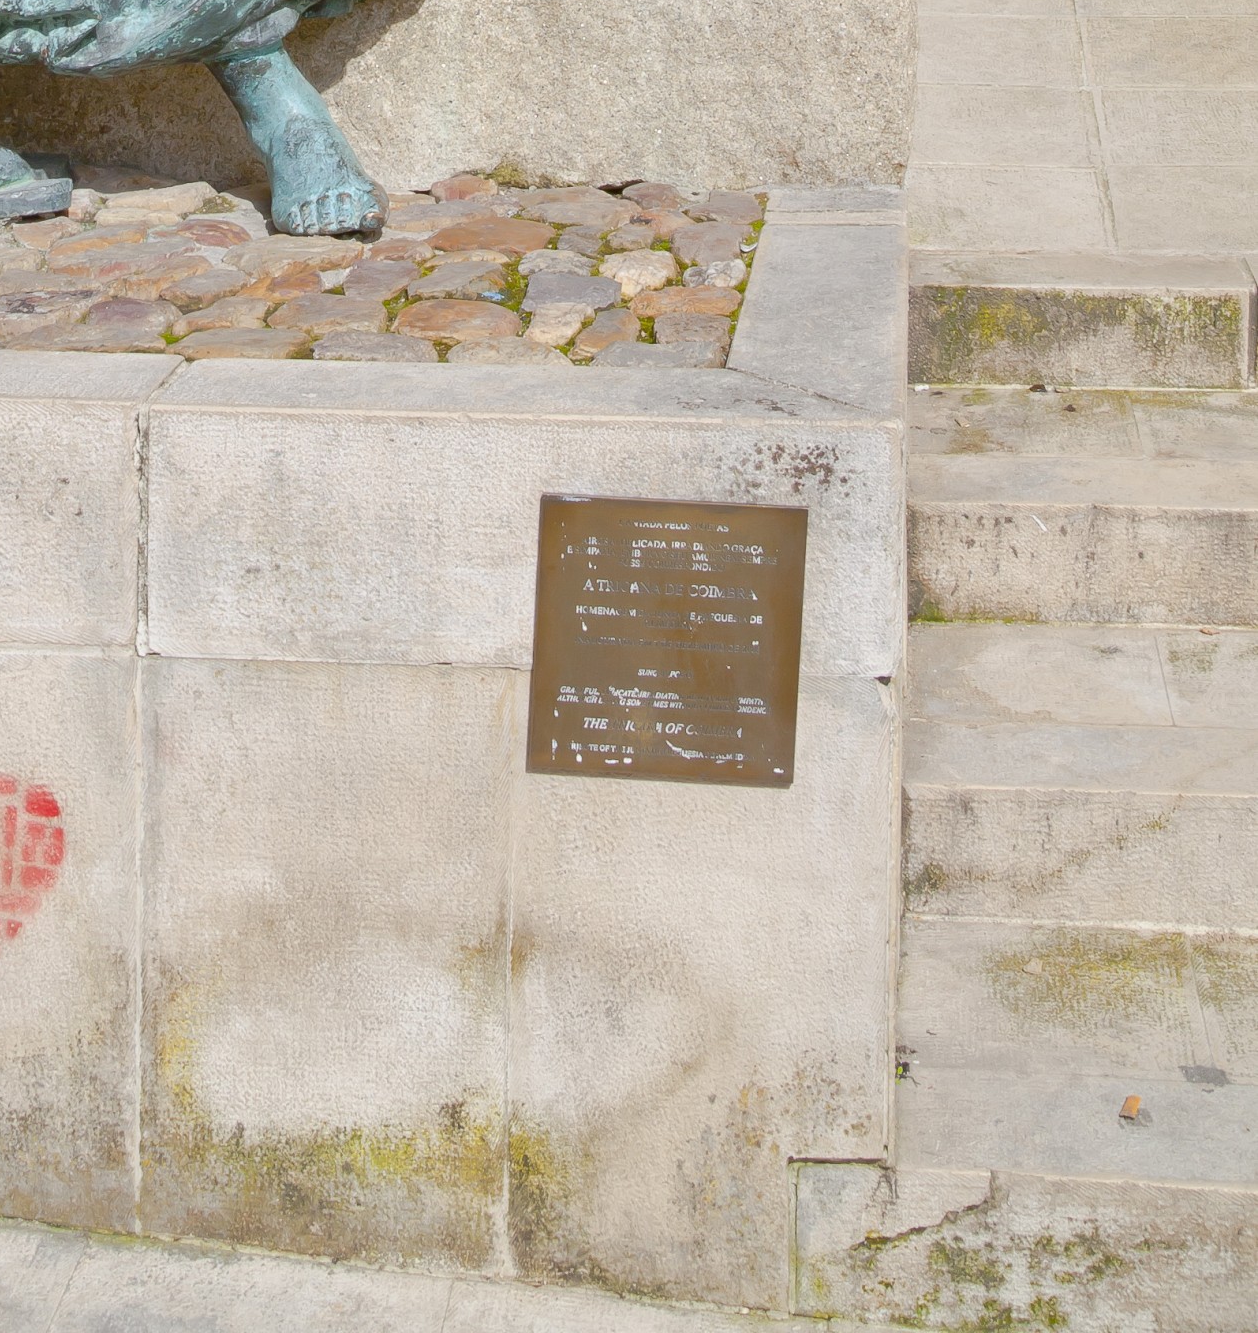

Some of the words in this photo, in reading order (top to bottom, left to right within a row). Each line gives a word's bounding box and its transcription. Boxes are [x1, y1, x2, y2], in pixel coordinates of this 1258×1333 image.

[731, 544, 764, 556] GRAÇA
[583, 579, 595, 592] A
[689, 585, 759, 601] COIMBRA
[749, 615, 763, 625] DE
[583, 717, 609, 731] THE
[665, 722, 684, 735] OF
